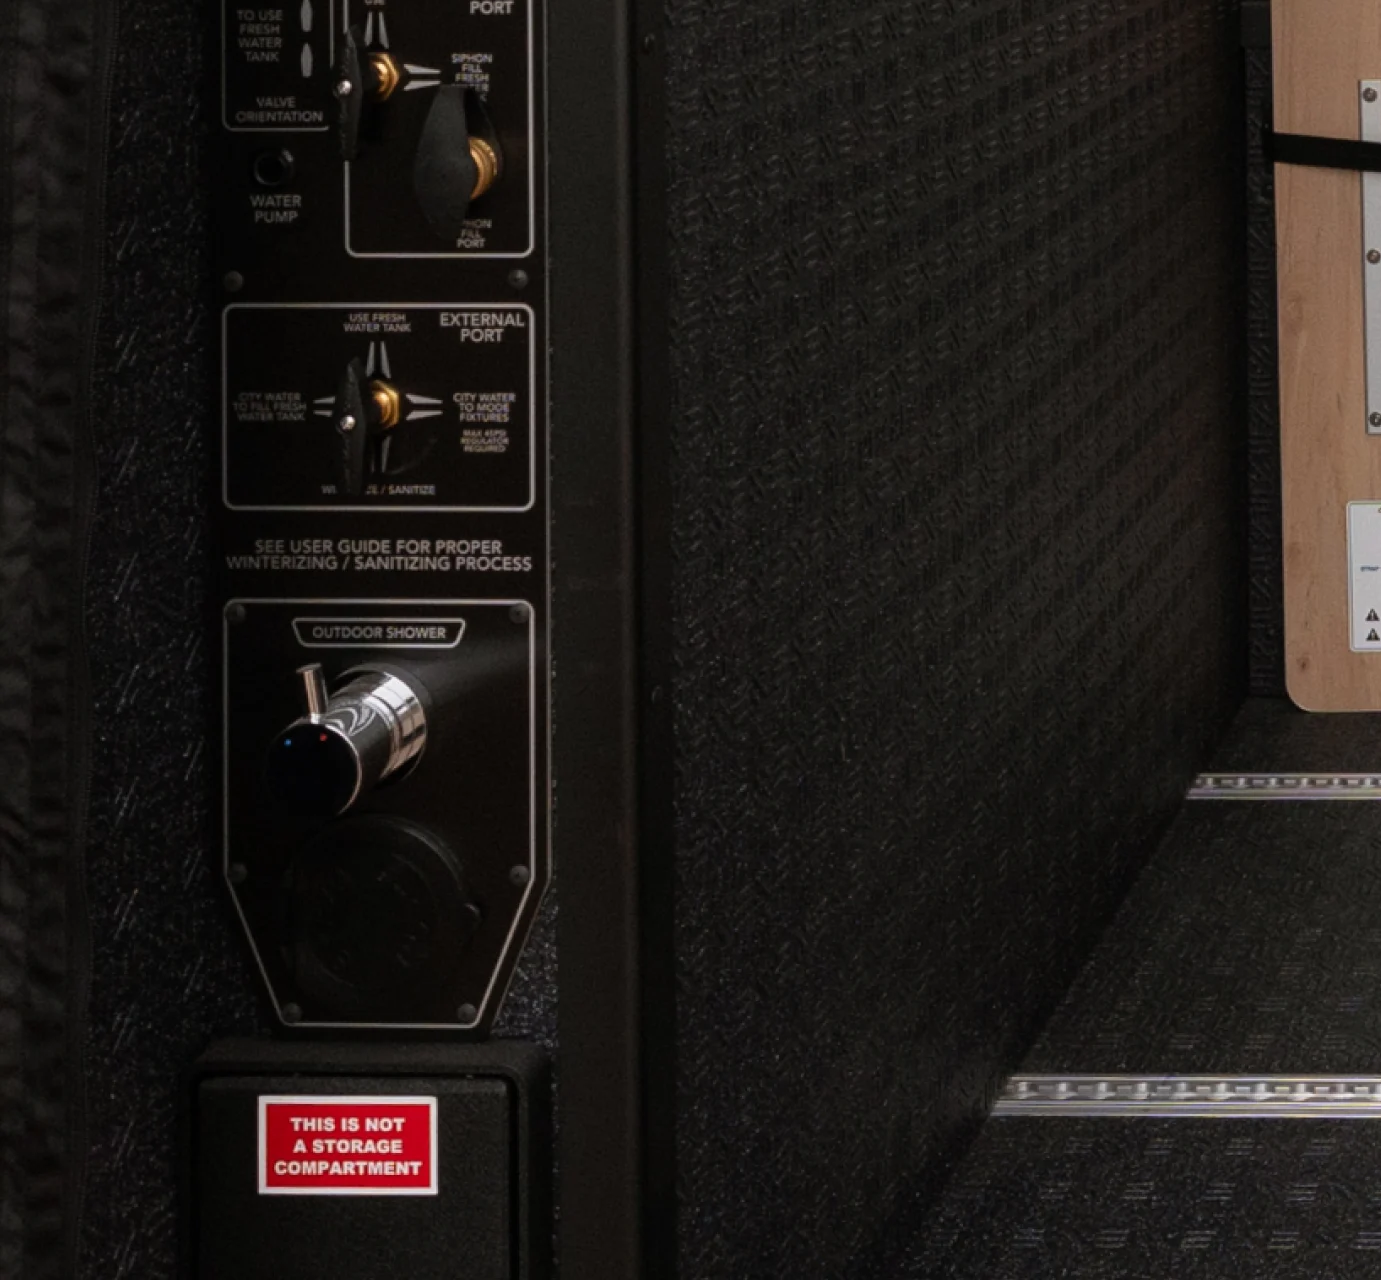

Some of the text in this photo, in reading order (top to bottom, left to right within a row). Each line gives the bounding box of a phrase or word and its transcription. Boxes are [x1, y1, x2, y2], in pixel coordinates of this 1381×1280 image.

[469, 0, 514, 16] PORT
[237, 9, 284, 21] TO USE
[239, 23, 281, 35] FRESH
[238, 37, 283, 49] WATER
[244, 51, 280, 62] TANK
[451, 53, 493, 63] SIPHON
[461, 64, 483, 72] FILL
[455, 73, 490, 82] FRESH
[256, 96, 297, 108] VALVE
[235, 111, 324, 123] ORIENTATION
[250, 194, 302, 207] WATER
[254, 211, 299, 223] PUMP
[456, 238, 486, 249] PORT
[349, 314, 406, 323] USE FRESH
[439, 312, 525, 327] EXTERNAL
[343, 324, 412, 333] WATER TANK
[460, 328, 504, 342] PORT
[238, 392, 302, 401] CITY WATER
[453, 392, 516, 402] CITY WATER
[273, 402, 307, 411] FRESH
[459, 403, 474, 412] TO
[237, 412, 306, 421] WATER TANK
[459, 413, 510, 422] FIXTURES
[388, 484, 436, 495] SANITIZE
[255, 540, 503, 554] SEE USER GUIDE FOR PROPER
[226, 556, 532, 571] WINTERIZING / SANITIZING PROCESS
[312, 626, 447, 640] OUTDOOR SHOWER
[290, 1117, 406, 1133] THIS IS NOT
[293, 1139, 404, 1154] A STORAGE
[274, 1160, 422, 1176] COMPARTMENT
